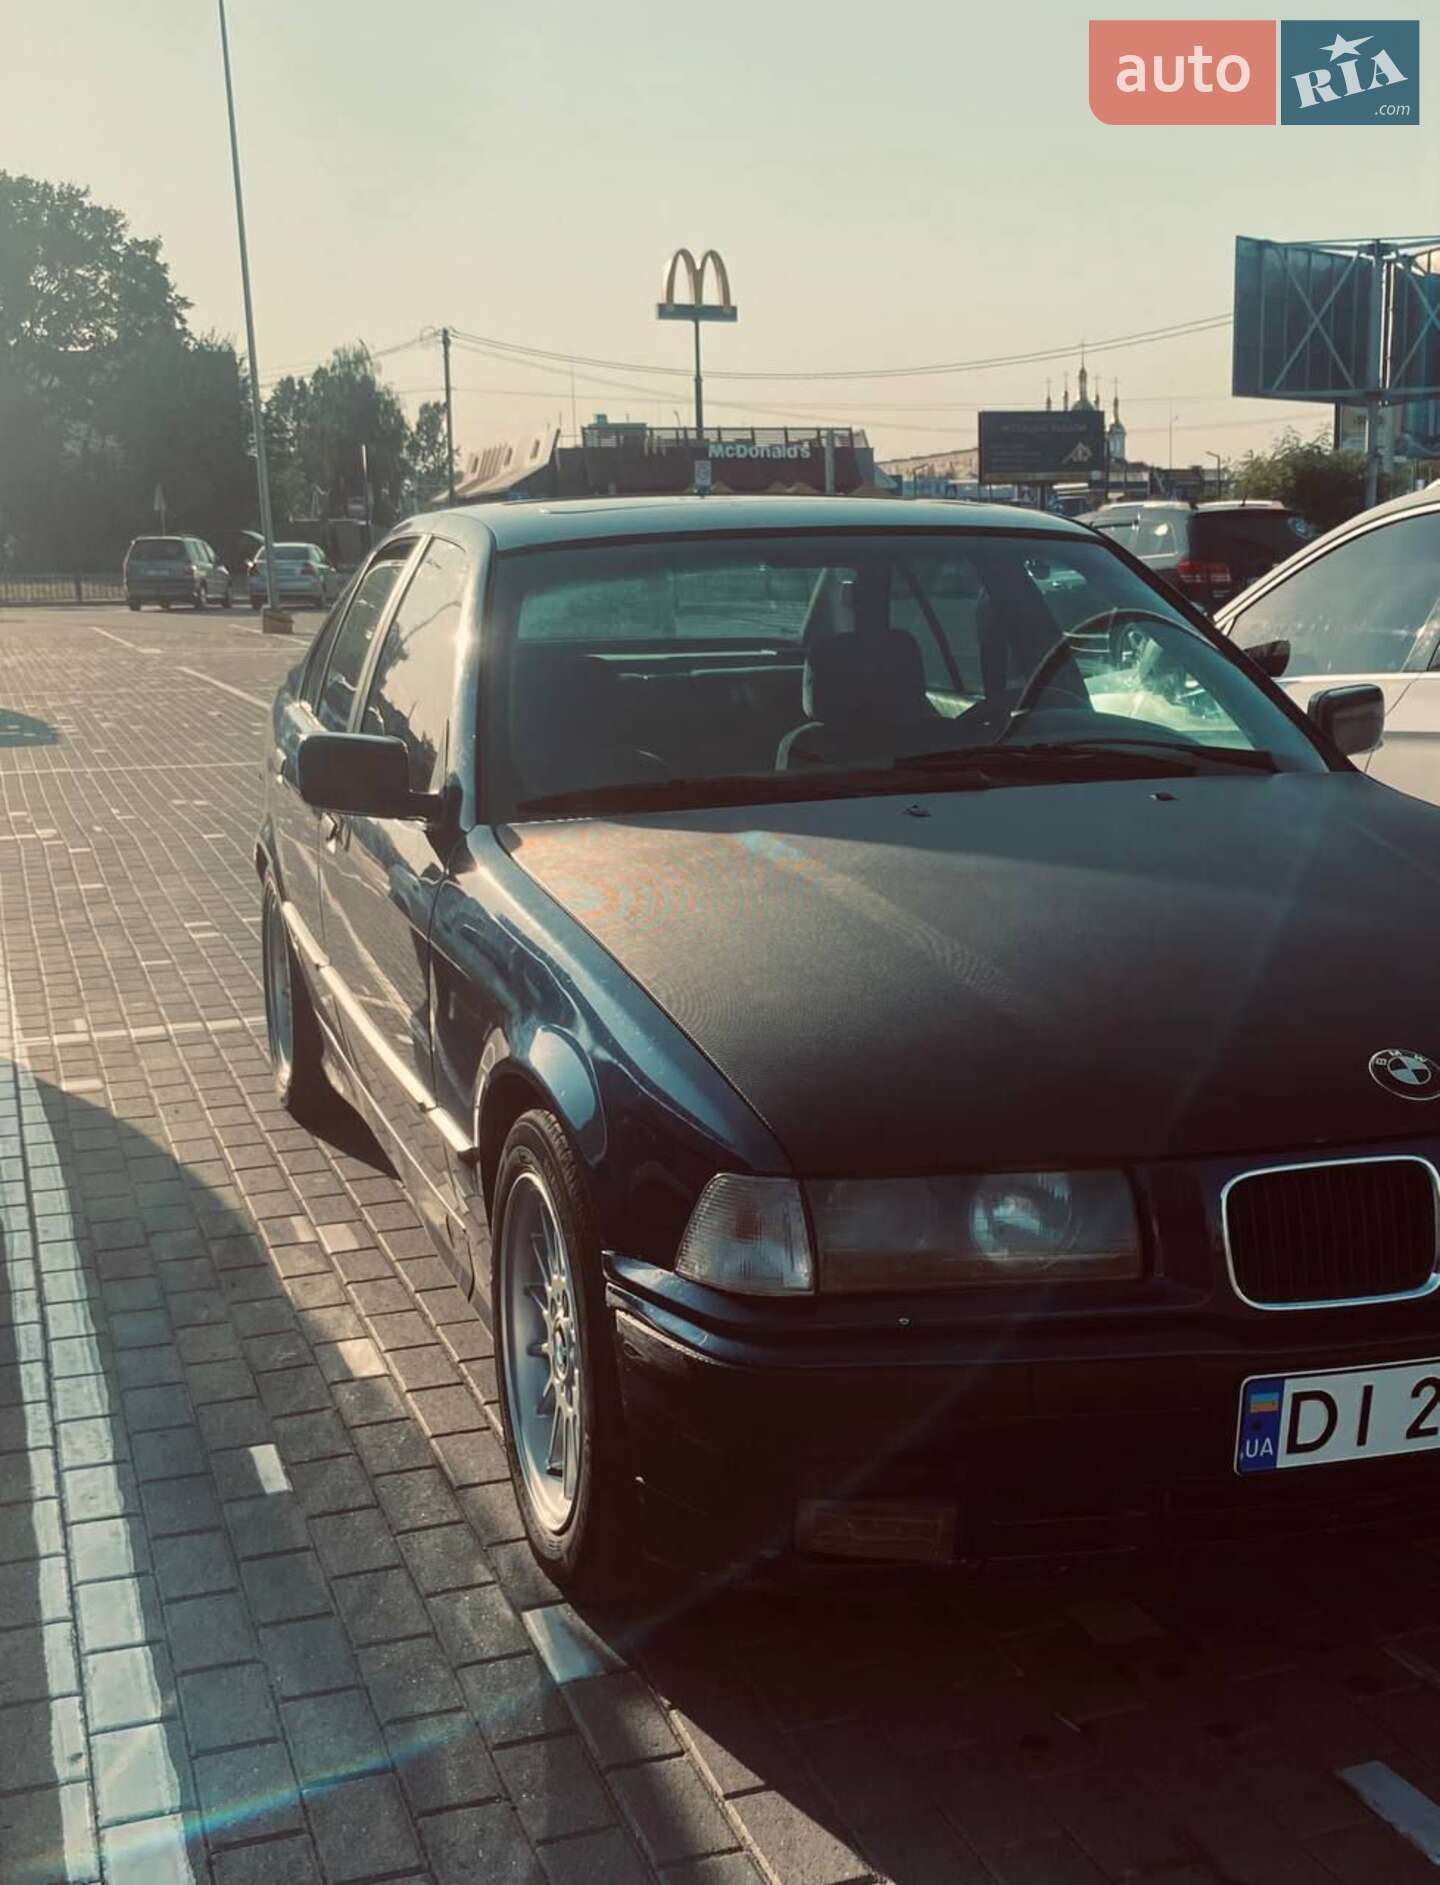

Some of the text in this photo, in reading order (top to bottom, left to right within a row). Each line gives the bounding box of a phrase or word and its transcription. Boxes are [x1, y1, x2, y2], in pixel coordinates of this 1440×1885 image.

[708, 443, 811, 459] McDonald's
[1286, 1385, 1374, 1454] DI
[1245, 1437, 1273, 1458] UA
